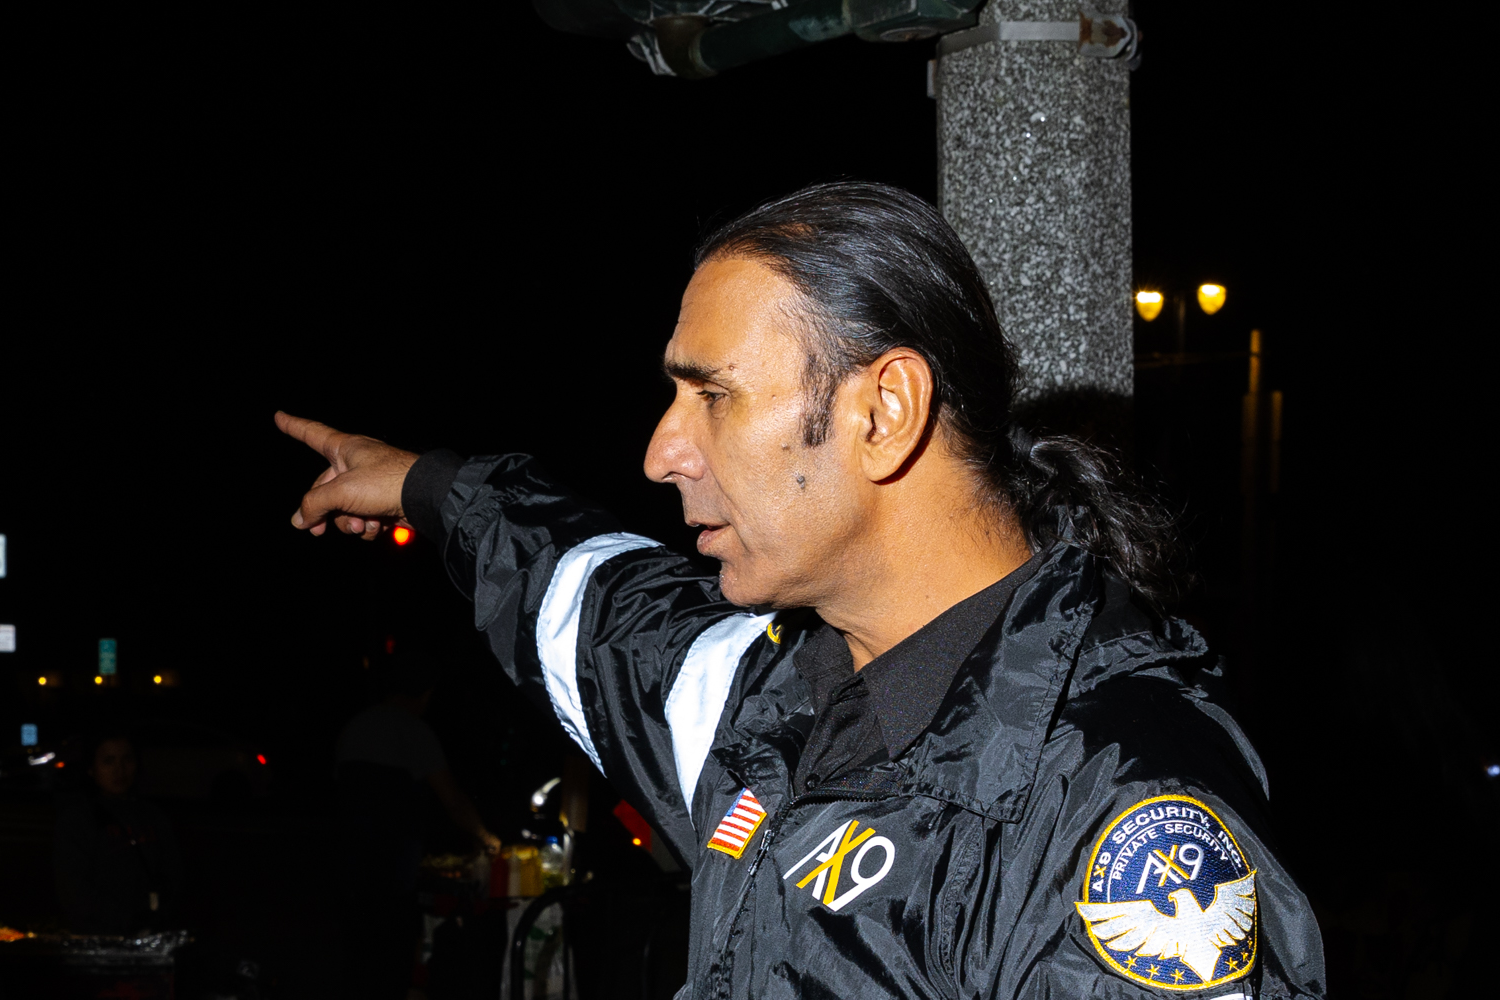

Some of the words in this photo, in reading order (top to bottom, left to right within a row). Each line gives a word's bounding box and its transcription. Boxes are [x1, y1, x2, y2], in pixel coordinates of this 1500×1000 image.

[783, 819, 896, 912] AX9
[1092, 851, 1112, 893] AX9
[1111, 828, 1159, 880] PRIVATE
[1164, 823, 1228, 861] SECURITY
[1136, 843, 1204, 894] AX9
